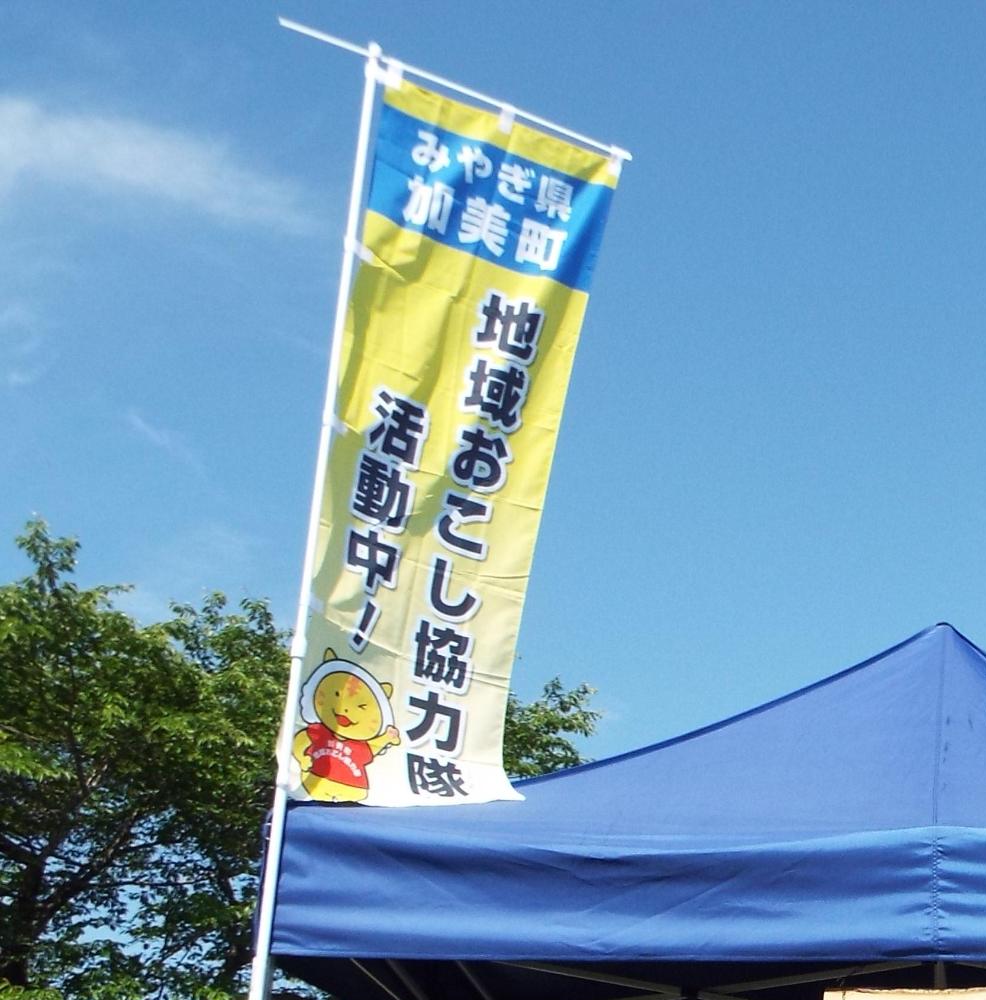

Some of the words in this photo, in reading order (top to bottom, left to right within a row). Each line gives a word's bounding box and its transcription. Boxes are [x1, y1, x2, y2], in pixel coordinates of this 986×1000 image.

[402, 176, 568, 271] 加美町
[411, 130, 575, 222] みやぎ県
[405, 293, 544, 798] 地域おこし協力隊
